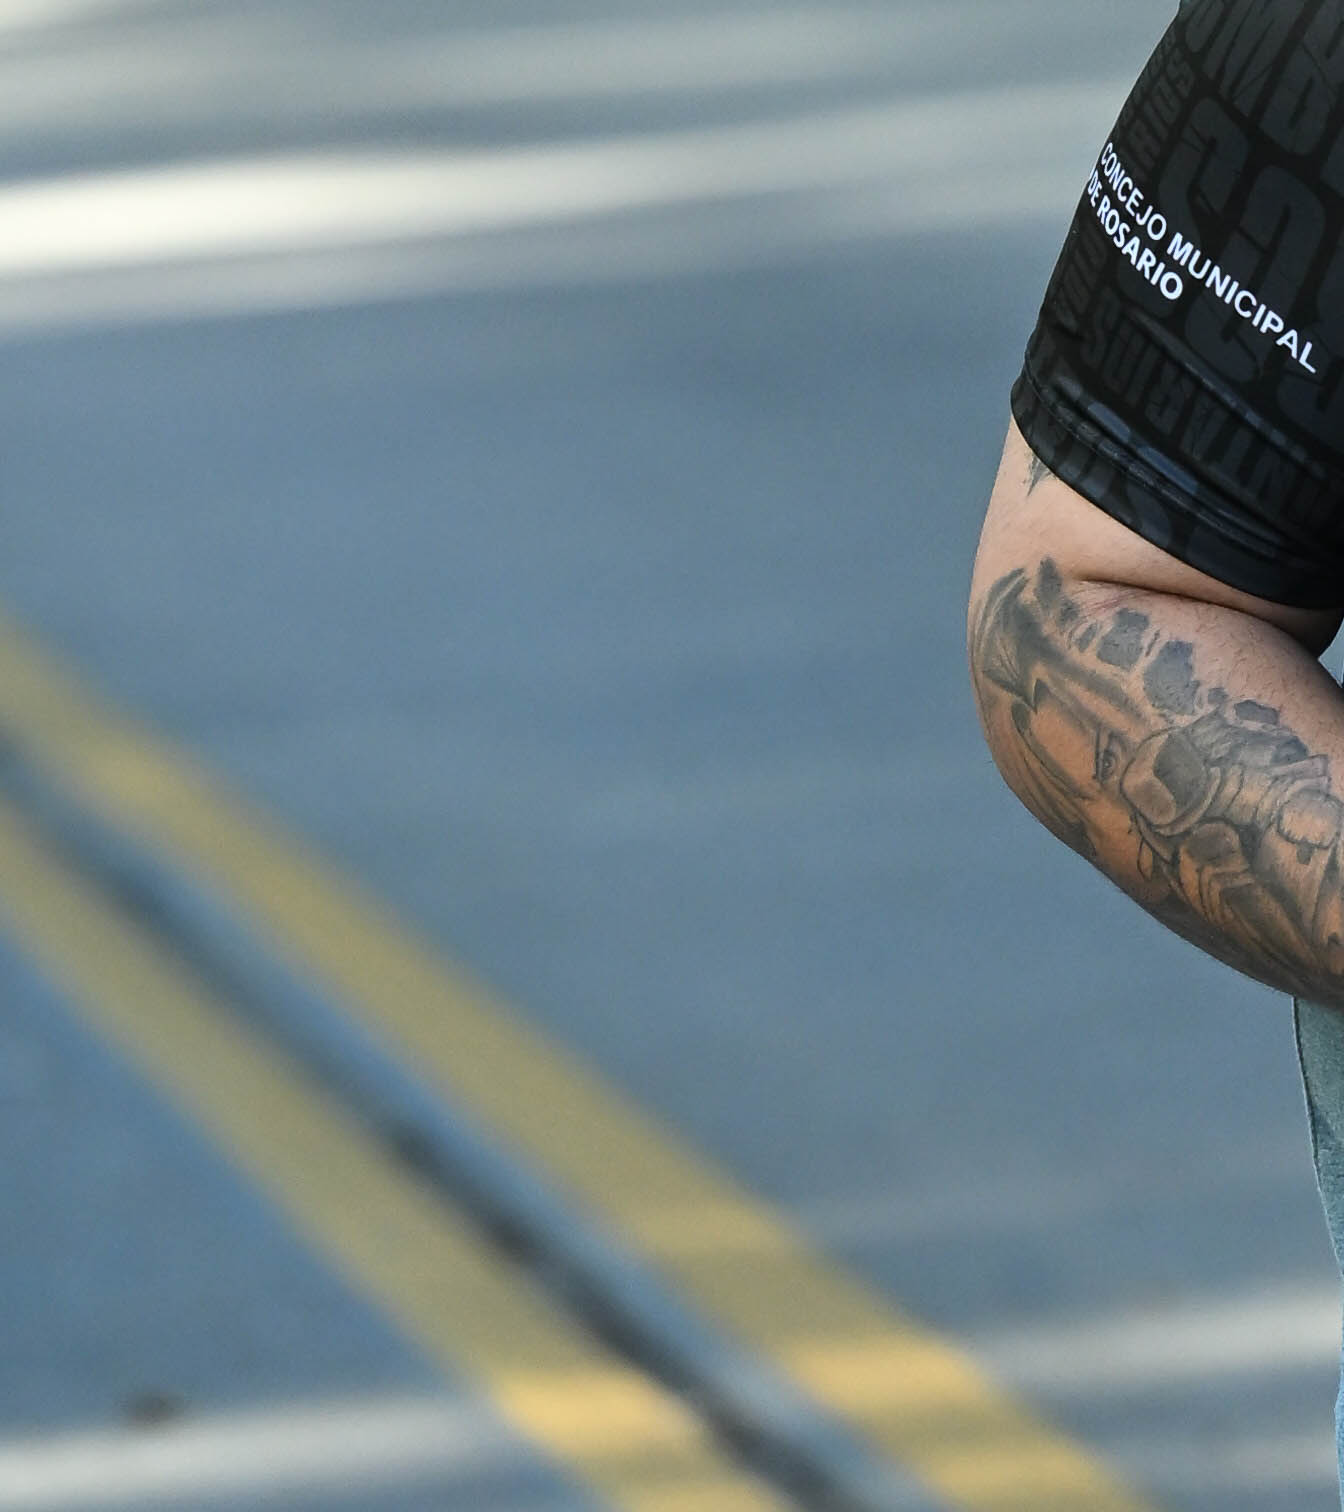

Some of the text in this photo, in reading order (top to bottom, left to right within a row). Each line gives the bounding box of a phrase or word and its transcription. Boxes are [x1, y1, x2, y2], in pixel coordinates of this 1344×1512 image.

[1087, 169, 1184, 300] DE ROSARIO
[1101, 142, 1167, 240] CONCEJO
[1167, 232, 1316, 374] MUNICIPAL
